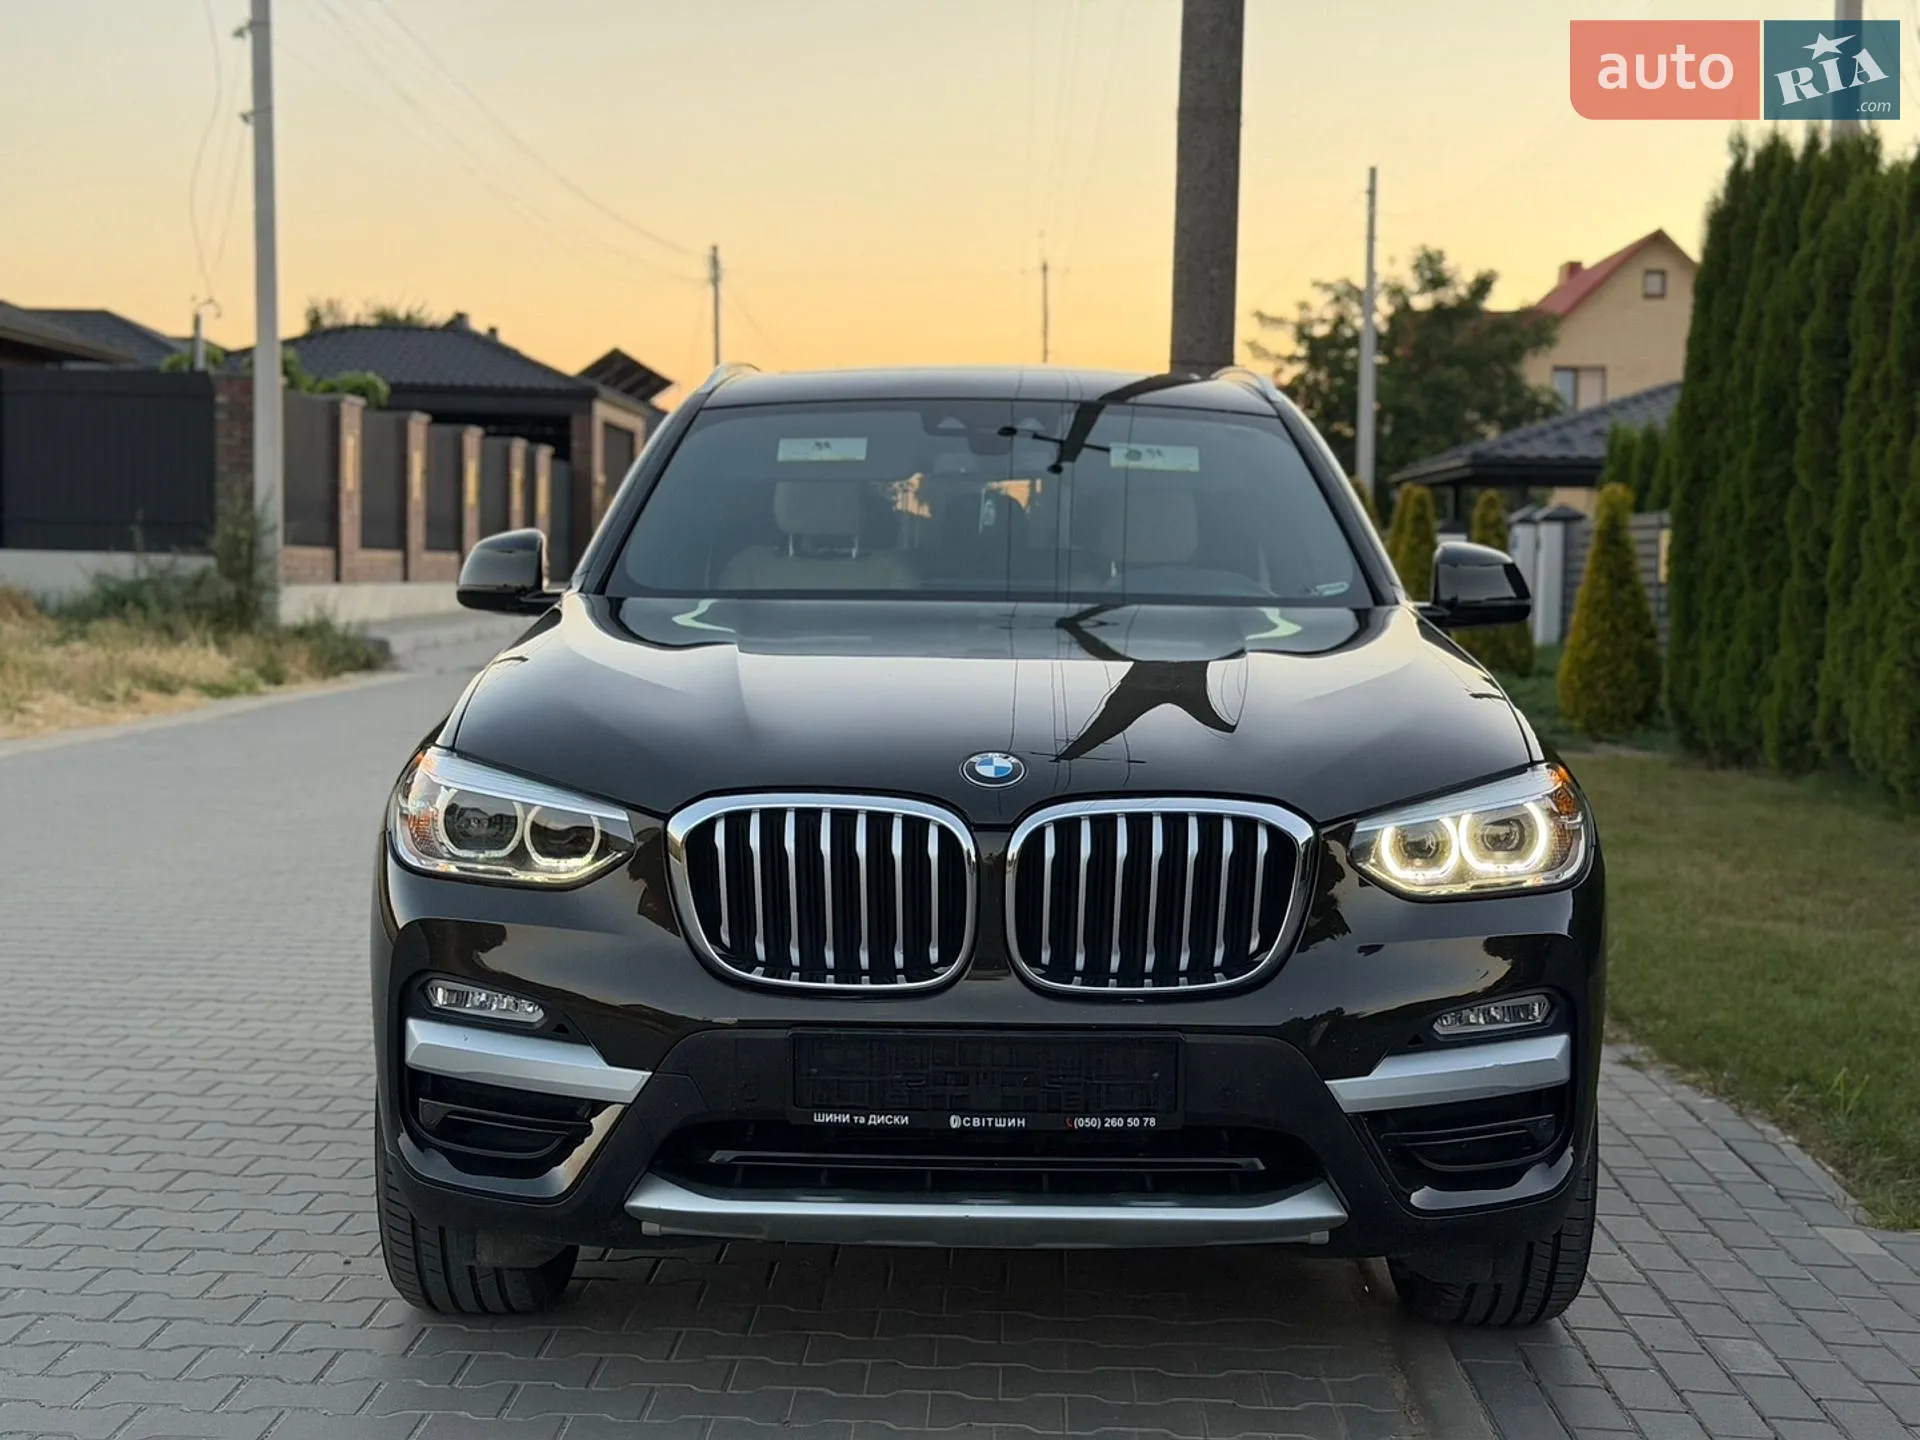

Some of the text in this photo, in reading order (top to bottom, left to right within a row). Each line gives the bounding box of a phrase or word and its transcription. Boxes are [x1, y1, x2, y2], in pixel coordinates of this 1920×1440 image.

[813, 1112, 909, 1126] ШИНИ та ДИСКИ
[962, 1116, 1026, 1128] СВІТШИН
[1073, 1117, 1156, 1129] (050) 260 50 78
